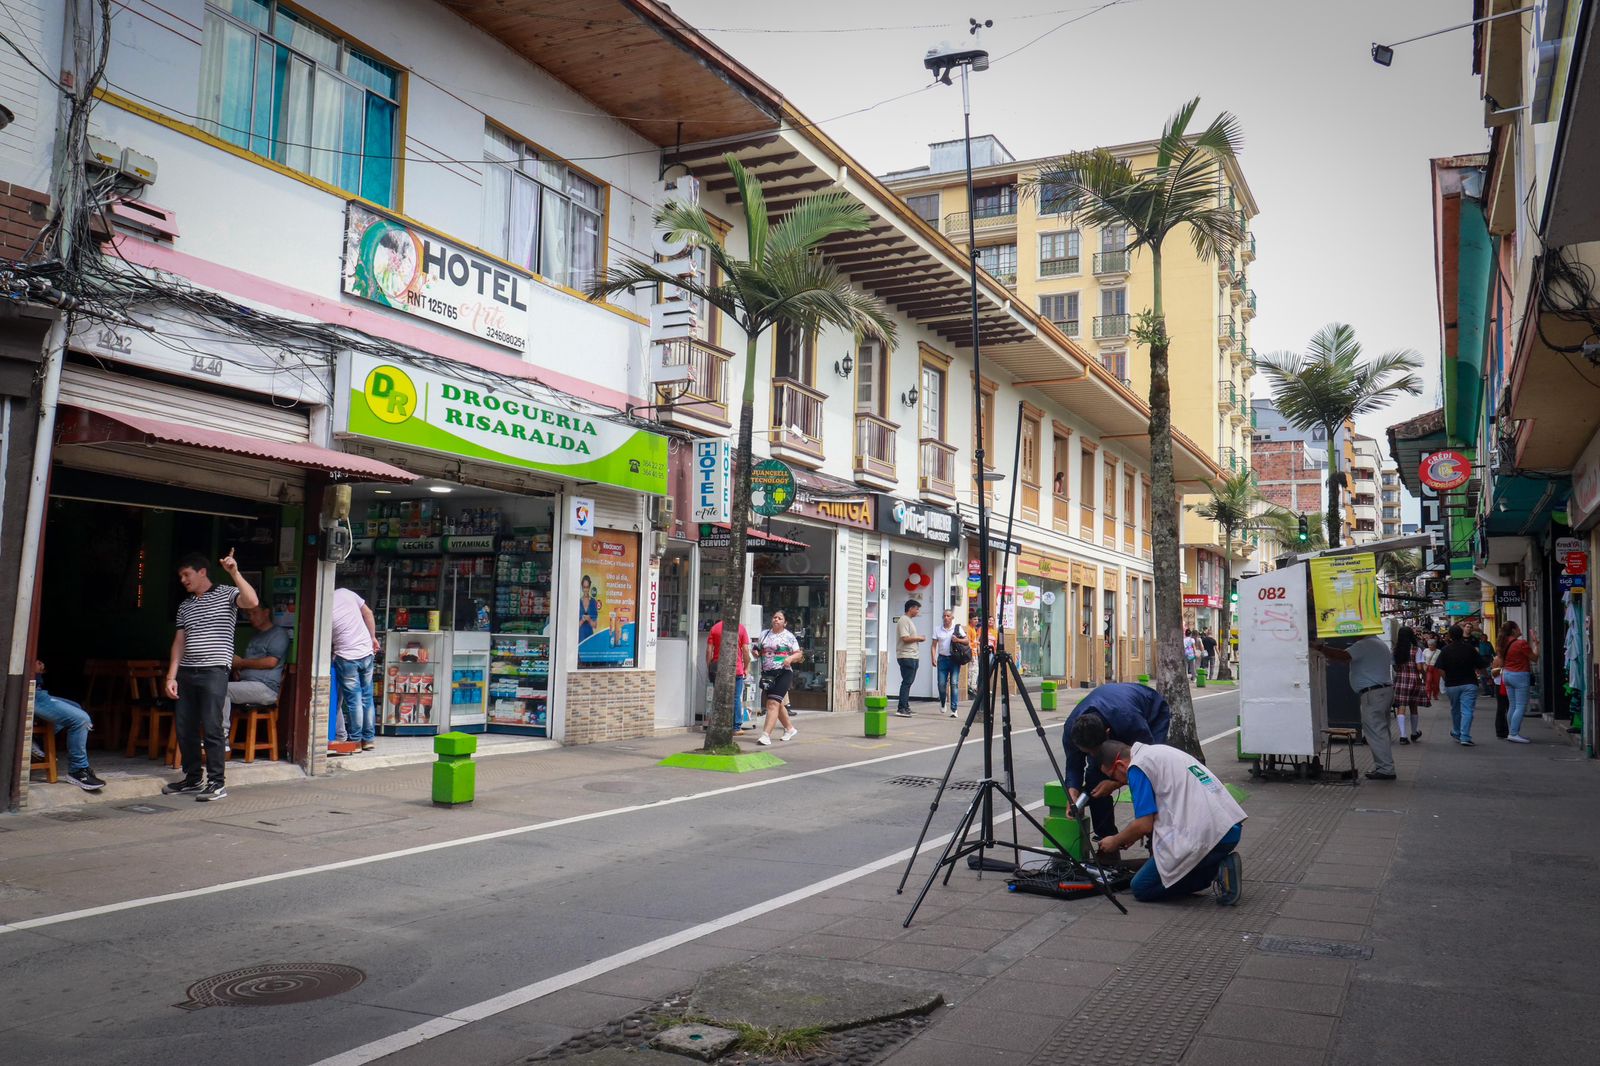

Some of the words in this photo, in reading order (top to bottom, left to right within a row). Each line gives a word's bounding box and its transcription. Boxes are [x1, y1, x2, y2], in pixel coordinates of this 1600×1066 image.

[422, 239, 527, 312] HOTEL
[407, 290, 427, 309] RNT
[428, 299, 458, 320] 125765
[459, 301, 505, 333] Arte
[441, 383, 598, 436] DROGUERIA
[445, 408, 591, 455] RISARALDA
[698, 441, 717, 507] HOTEL
[817, 497, 871, 525] AMIGA
[402, 541, 434, 550] LECHES
[451, 540, 490, 548] VITAMINAS
[1257, 587, 1286, 600] 082
